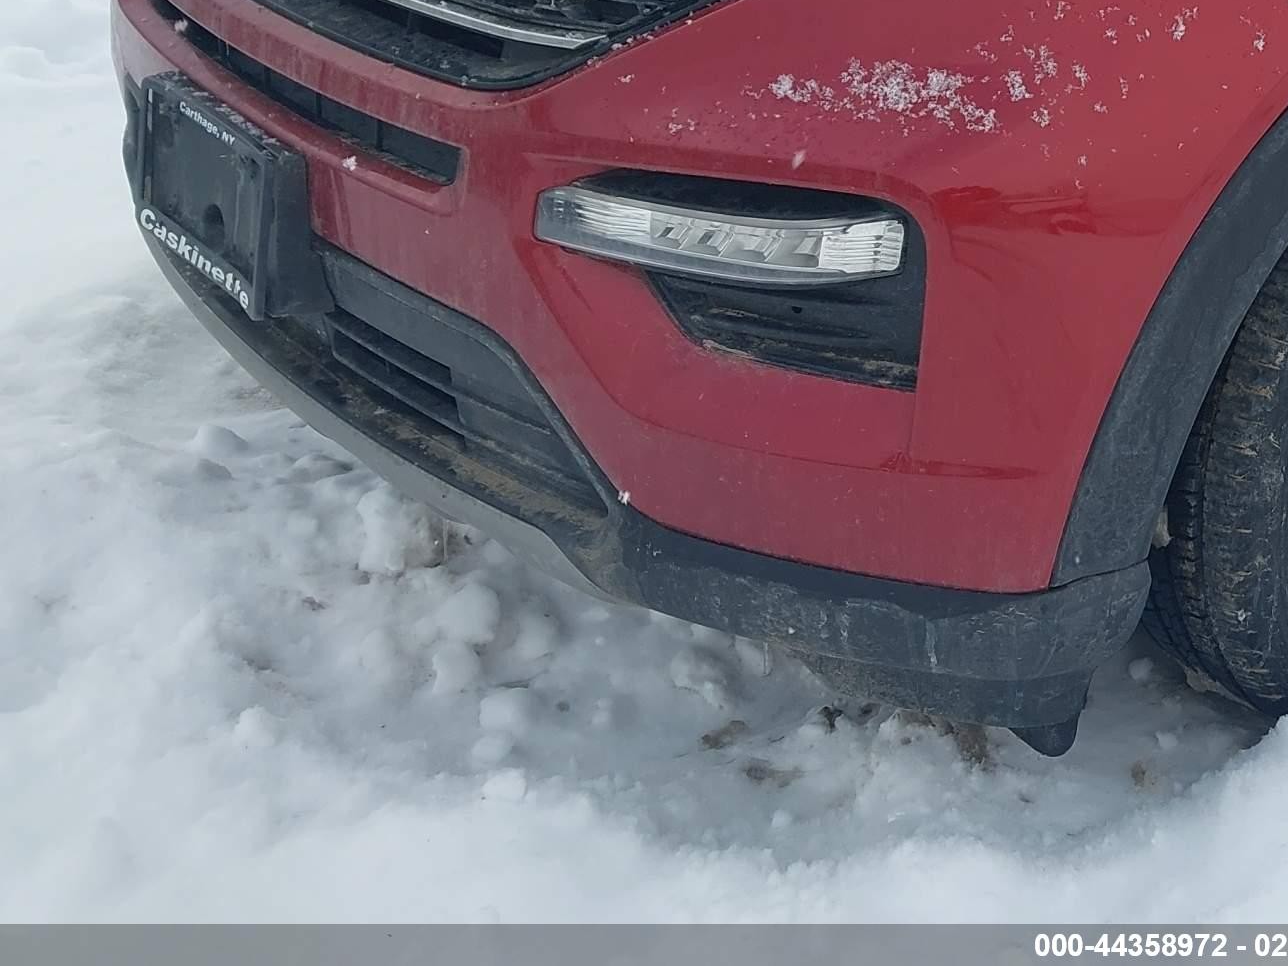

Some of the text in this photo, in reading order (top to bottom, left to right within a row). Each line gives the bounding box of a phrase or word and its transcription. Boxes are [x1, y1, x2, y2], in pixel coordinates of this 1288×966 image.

[179, 101, 236, 146] Carthage, NY
[140, 208, 249, 309] Caskinette
